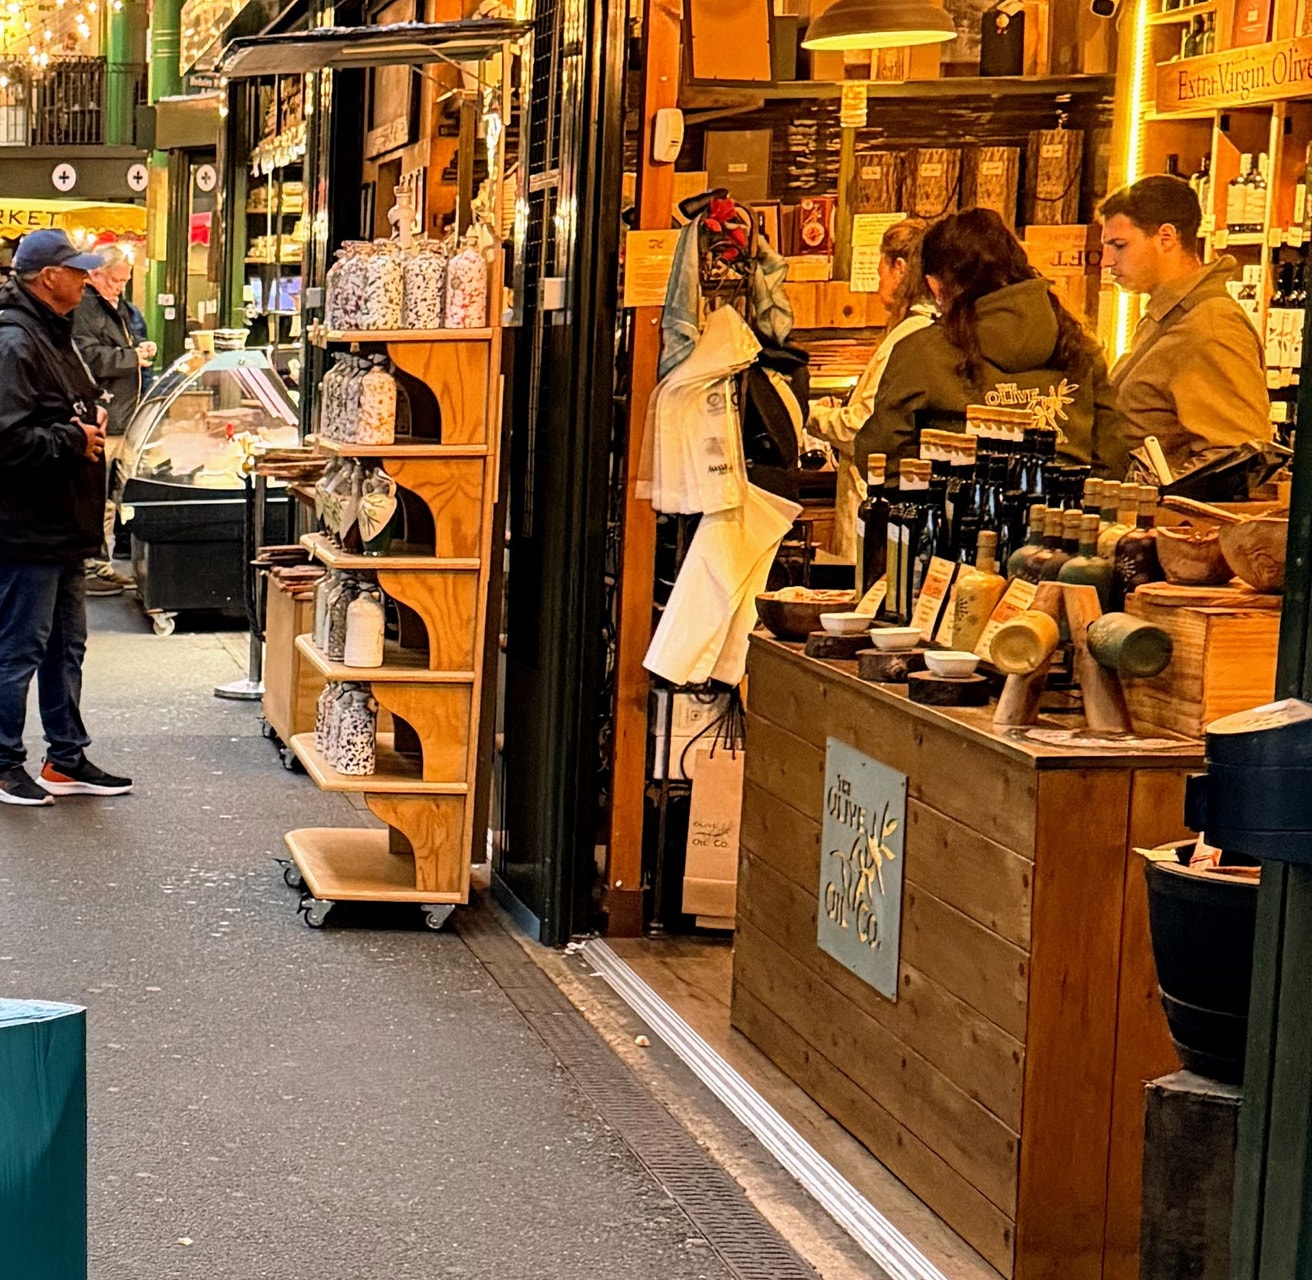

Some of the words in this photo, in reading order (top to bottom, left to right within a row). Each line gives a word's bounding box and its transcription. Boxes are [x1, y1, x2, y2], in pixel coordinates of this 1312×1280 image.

[1178, 71, 1216, 100] Extra
[984, 388, 1040, 405] OLIVE
[827, 785, 867, 837] OLIVE
[824, 880, 849, 929] OIL
